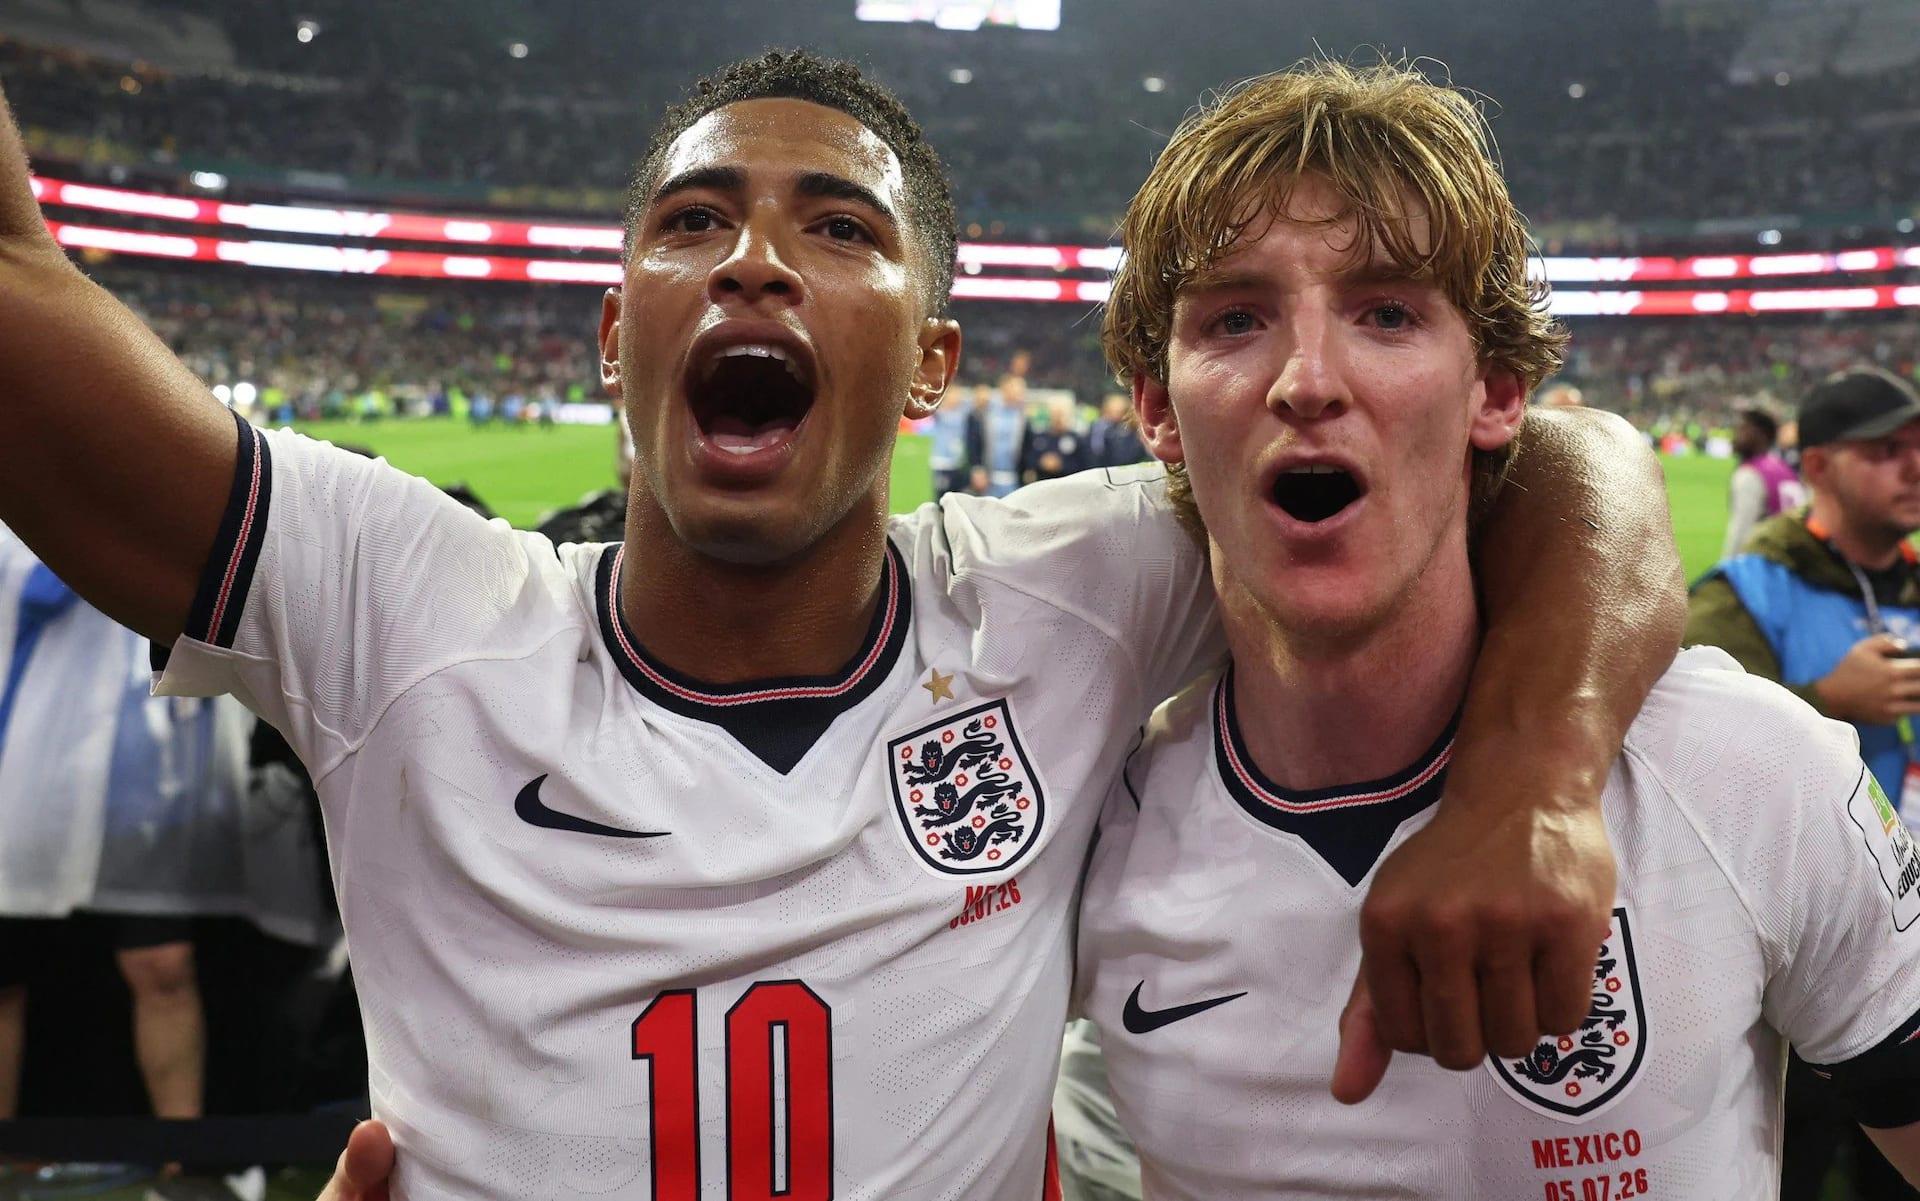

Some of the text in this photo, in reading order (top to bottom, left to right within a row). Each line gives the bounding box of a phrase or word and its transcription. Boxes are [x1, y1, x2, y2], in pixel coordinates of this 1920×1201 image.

[632, 979, 834, 1201] 10
[1532, 1129, 1641, 1169] MEXICO
[1545, 1168, 1648, 1201] 0507.26
